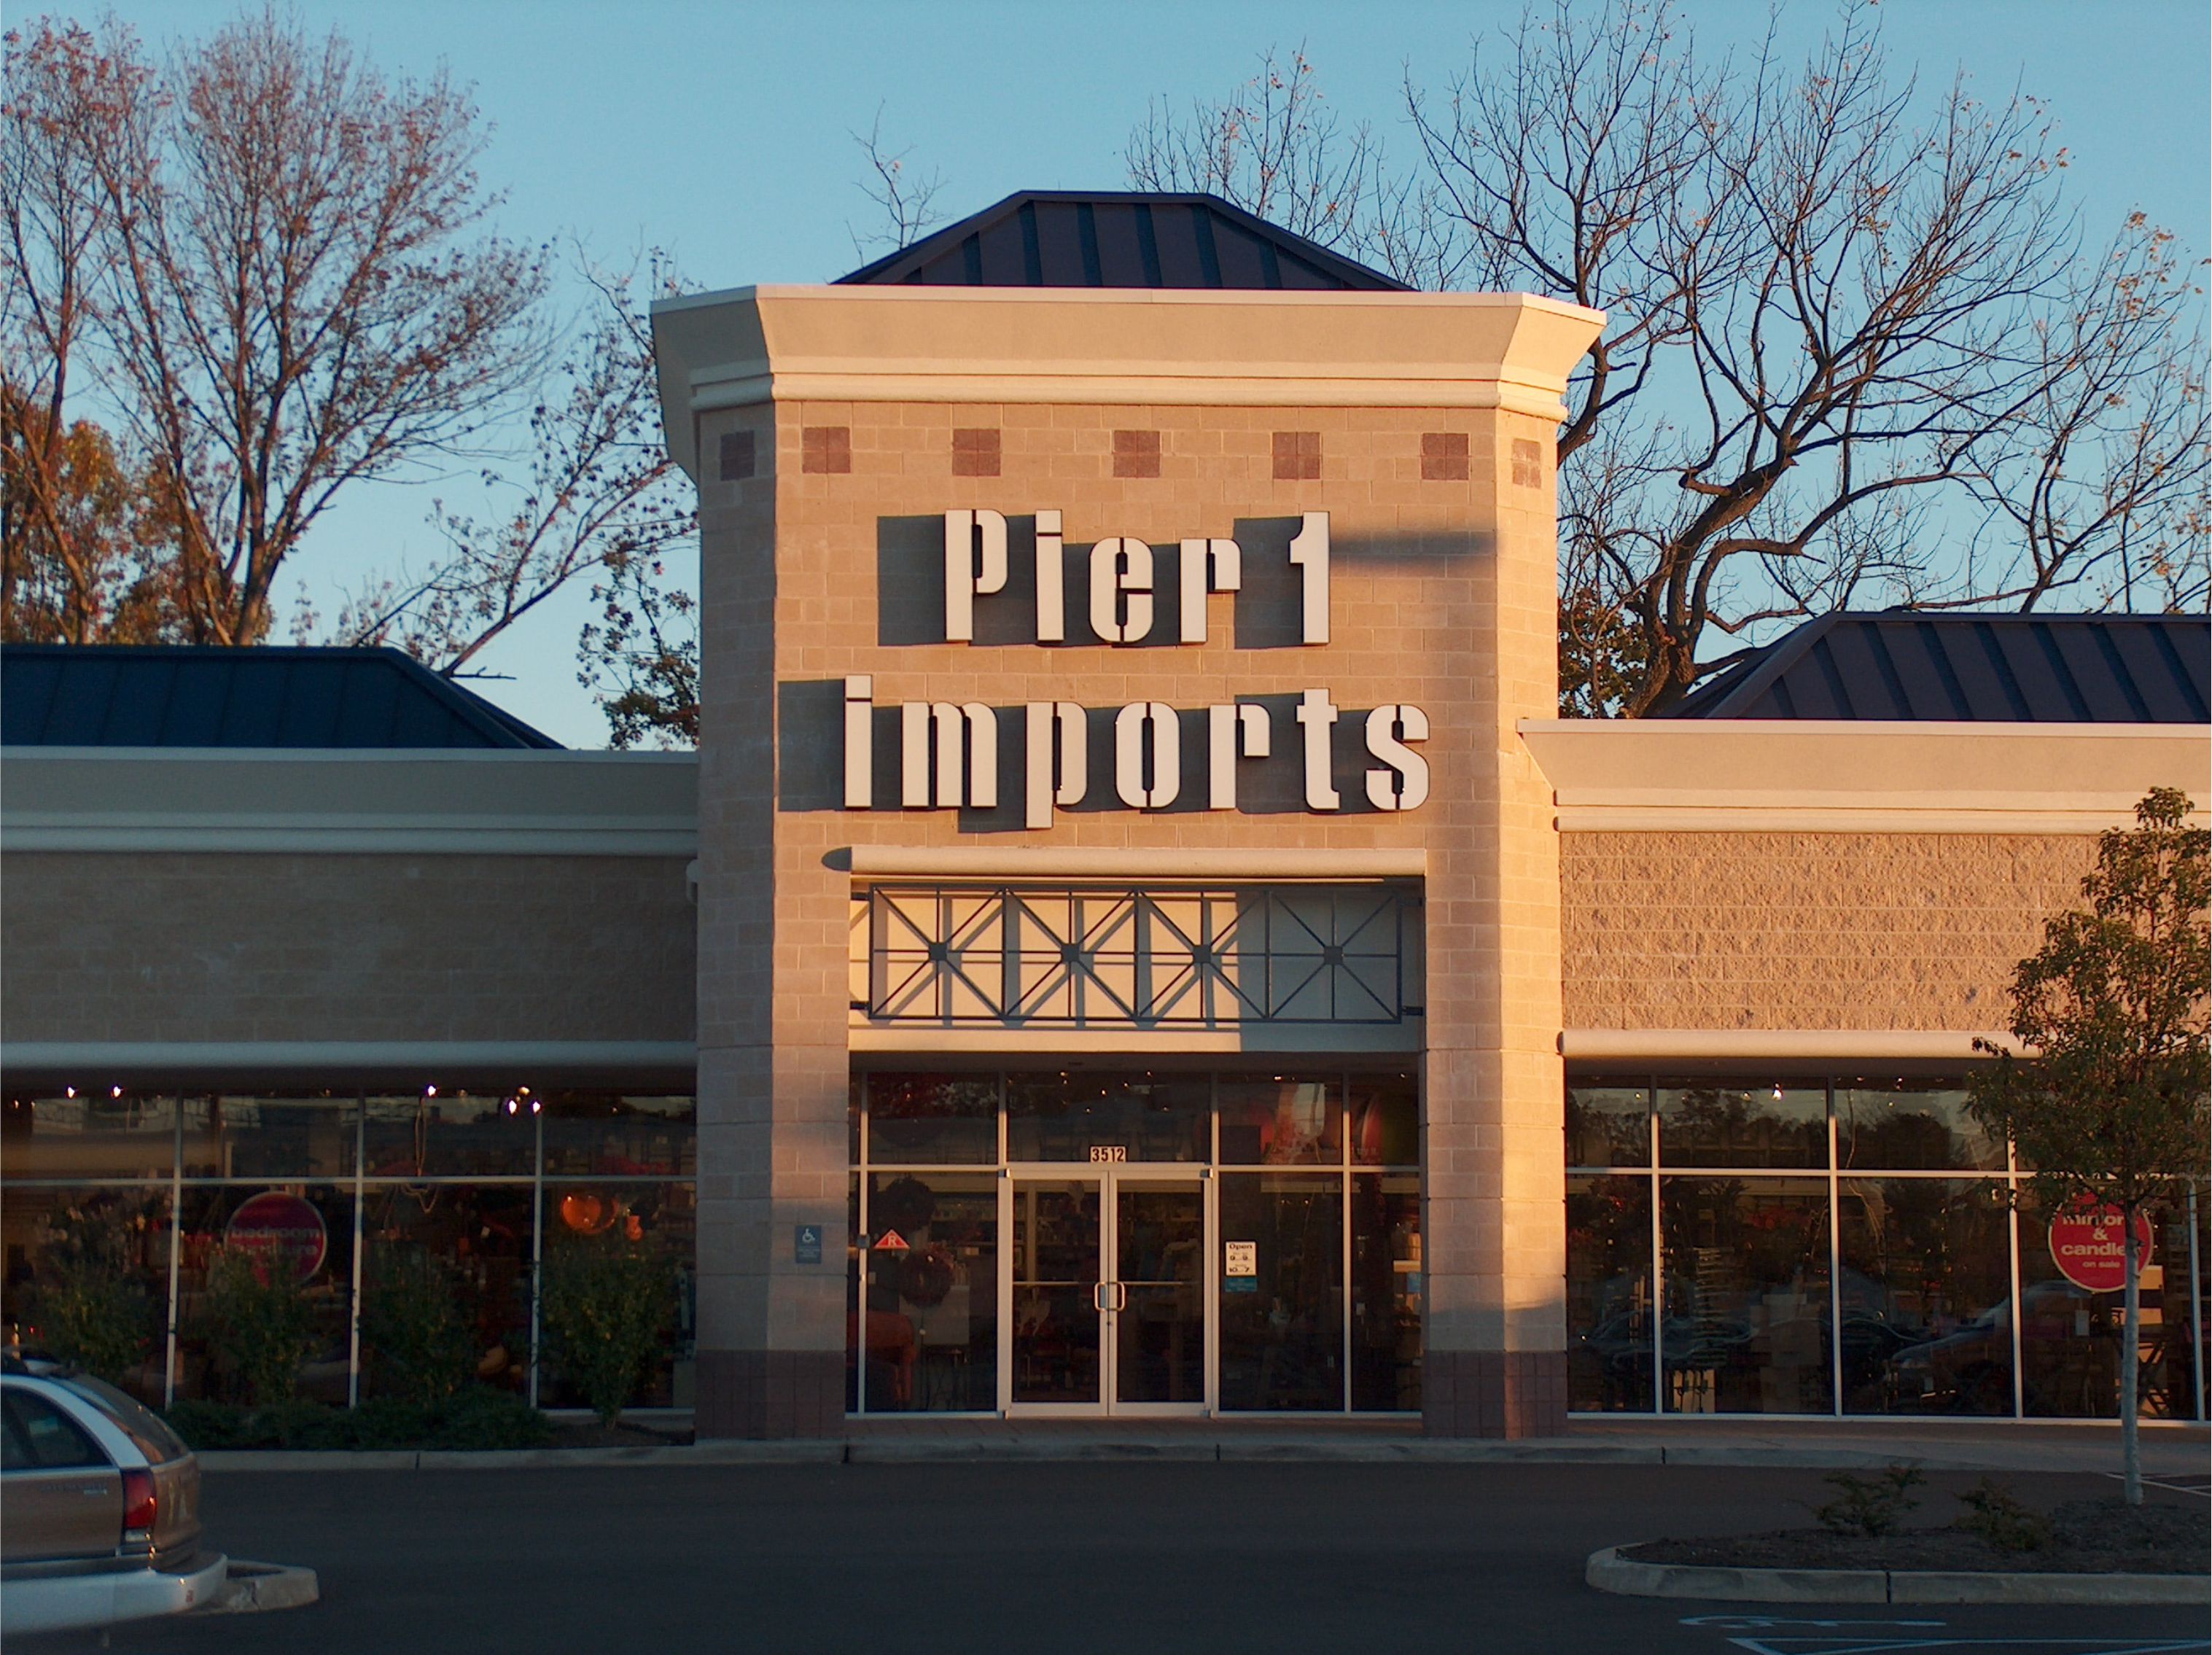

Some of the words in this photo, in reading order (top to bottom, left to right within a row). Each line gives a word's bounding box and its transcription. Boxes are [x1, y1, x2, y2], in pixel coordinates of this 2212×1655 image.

[945, 508, 1242, 644] Pier
[1288, 510, 1331, 645] 1
[844, 674, 1431, 830] imports
[1092, 1148, 1124, 1162] 3512
[2092, 1227, 2109, 1241] &
[2060, 1242, 2126, 1255] candle
[2098, 1261, 2121, 1269] sale
